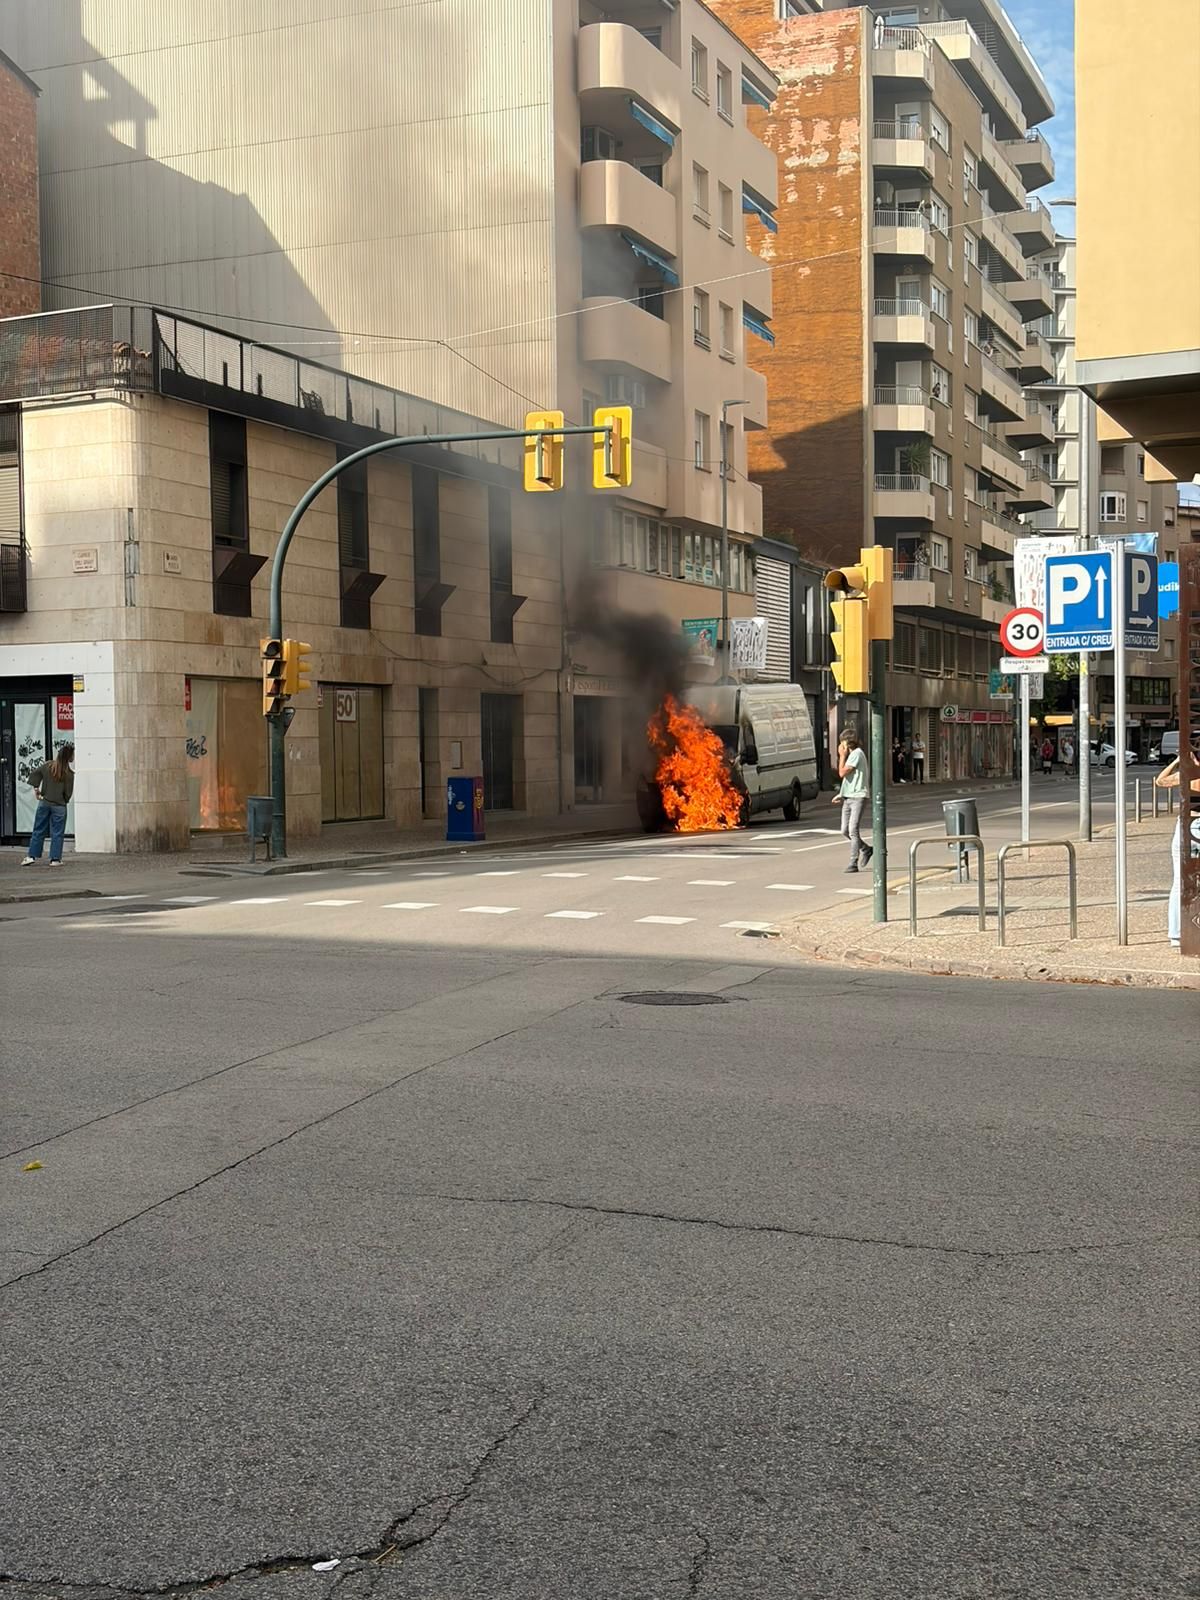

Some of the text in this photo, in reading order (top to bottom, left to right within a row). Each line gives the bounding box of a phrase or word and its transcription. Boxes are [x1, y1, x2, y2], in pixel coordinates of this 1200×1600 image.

[1131, 558, 1151, 611] P
[1158, 581, 1180, 592] udik
[1049, 563, 1091, 625] P
[1011, 624, 1040, 640] 30
[1047, 634, 1112, 648] ENTRADA C/ CREU
[1125, 634, 1142, 645] ENTRADA
[58, 703, 73, 712] FAC
[337, 694, 353, 717] 50
[58, 712, 74, 720] mob
